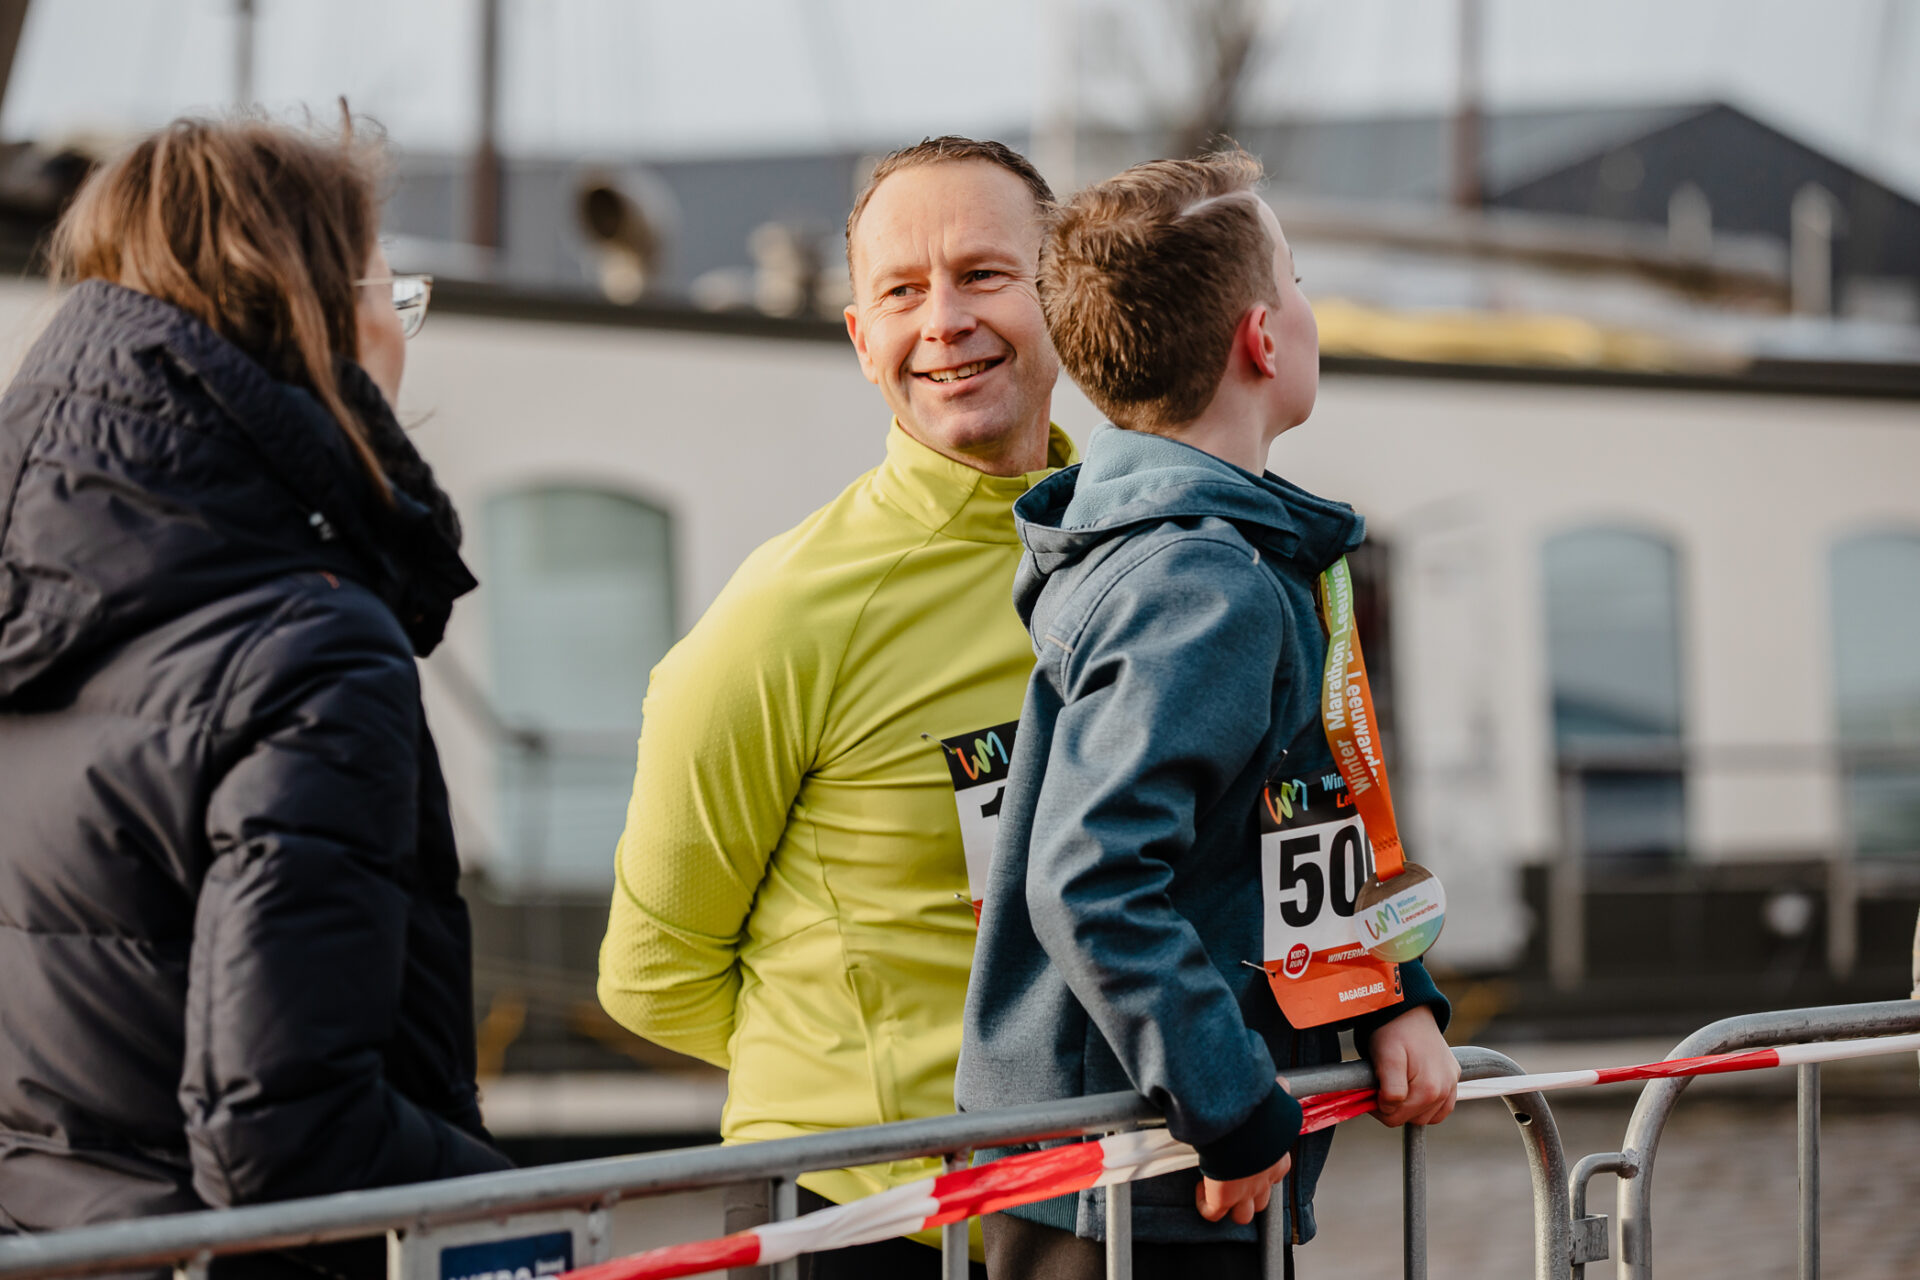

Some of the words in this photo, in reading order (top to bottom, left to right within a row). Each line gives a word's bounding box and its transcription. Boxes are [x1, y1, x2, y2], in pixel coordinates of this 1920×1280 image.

[1332, 560, 1349, 637] Leeuwa
[1326, 640, 1346, 731] Marathon
[1337, 739, 1371, 796] Winter
[1321, 773, 1346, 791] Win
[1289, 958, 1304, 969] RUN
[1290, 948, 1306, 960] KIDS
[1327, 947, 1371, 964] WINTERMA
[1338, 982, 1386, 1003] BAGAGELABEL
